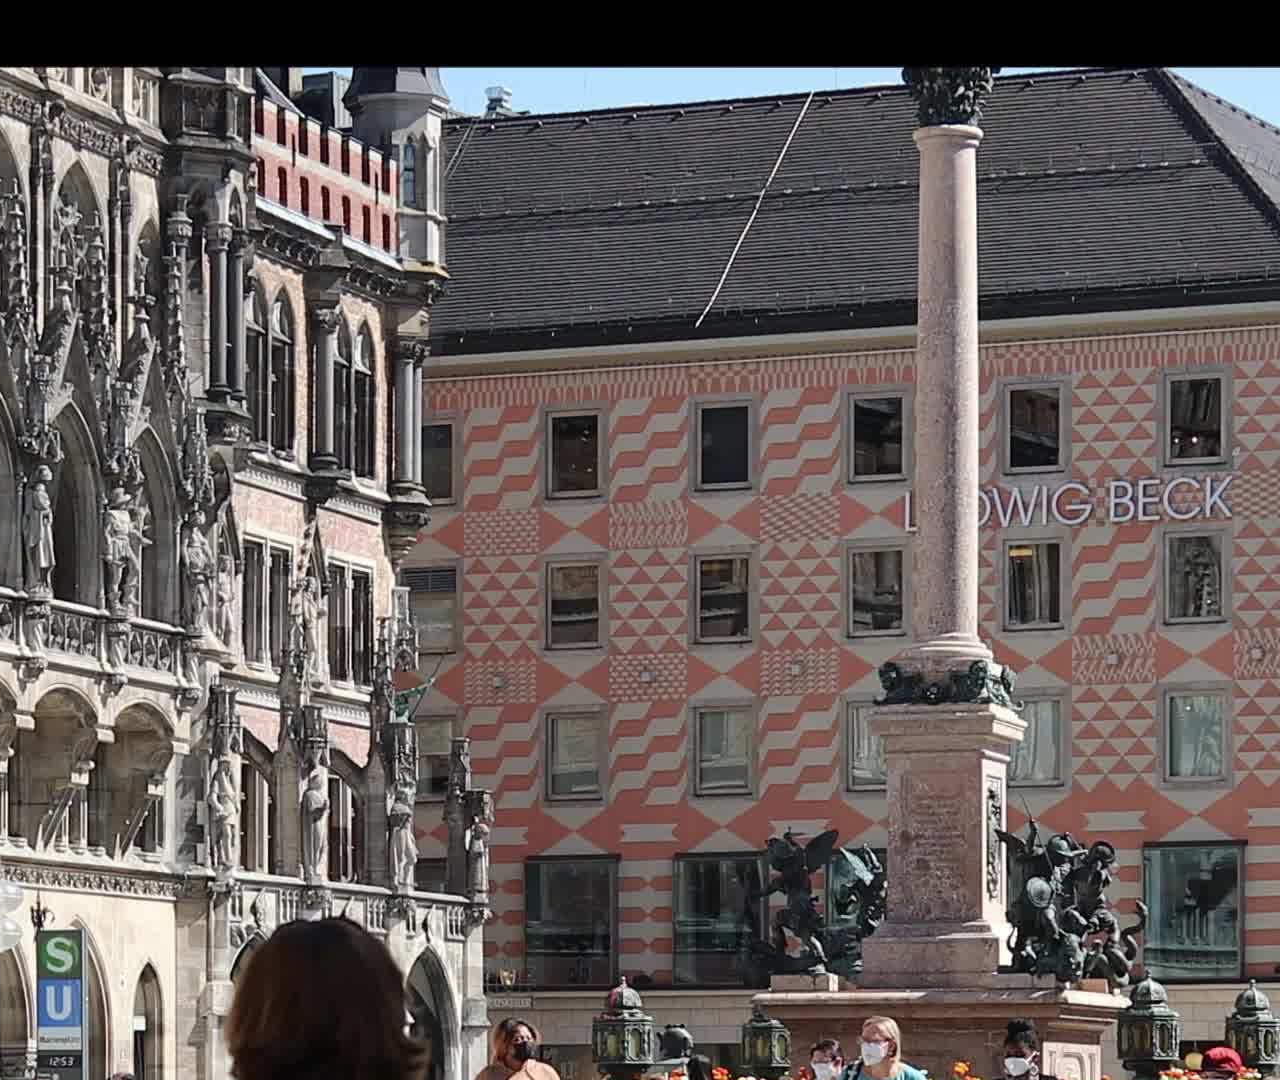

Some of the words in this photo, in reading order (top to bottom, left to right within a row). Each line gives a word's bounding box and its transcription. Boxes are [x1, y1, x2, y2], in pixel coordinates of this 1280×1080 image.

[904, 481, 1093, 533] LWIG
[1108, 475, 1234, 523] BECK
[46, 936, 73, 973] S
[46, 985, 72, 1020] U
[48, 1056, 75, 1067] 12:53
